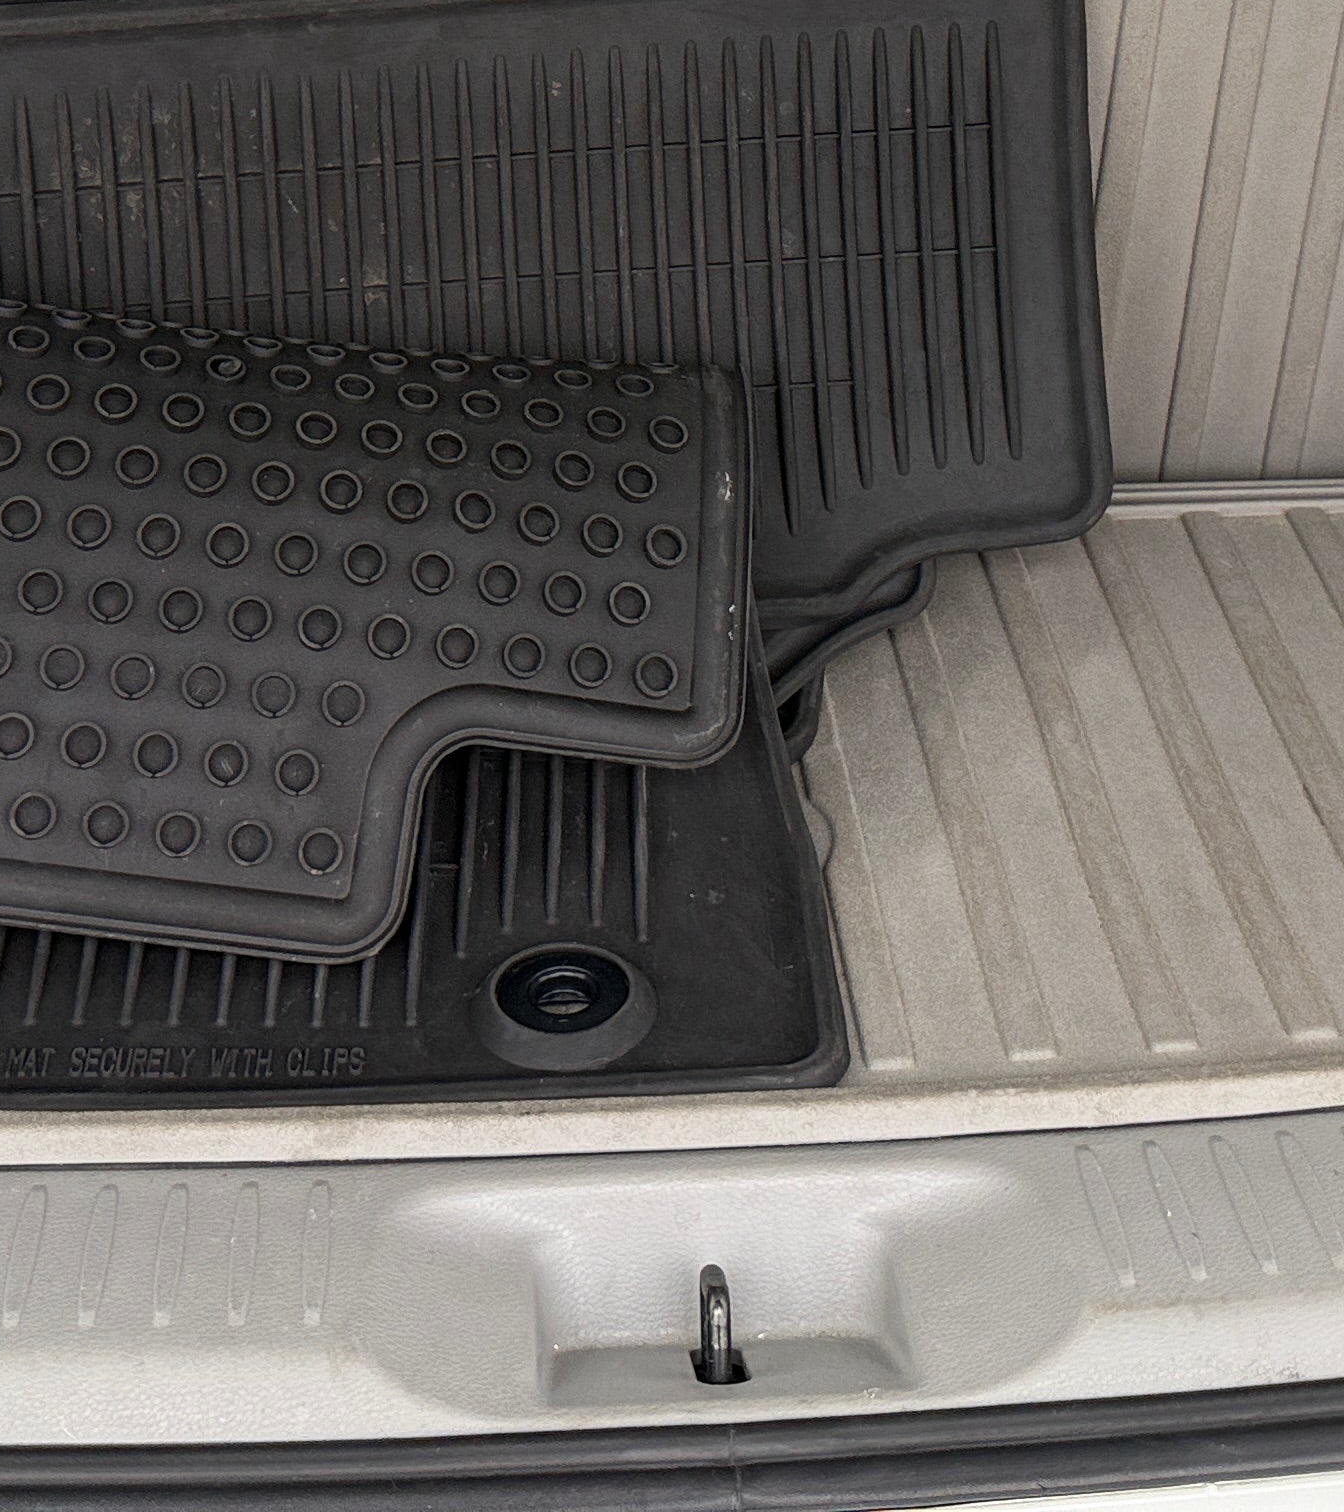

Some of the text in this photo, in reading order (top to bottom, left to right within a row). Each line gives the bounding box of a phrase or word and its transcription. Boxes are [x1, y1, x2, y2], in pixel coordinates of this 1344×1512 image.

[4, 1046, 57, 1079] MAT
[68, 1046, 197, 1079] SECURELY
[208, 1046, 274, 1079] WITH
[285, 1045, 369, 1078] CLIPS
